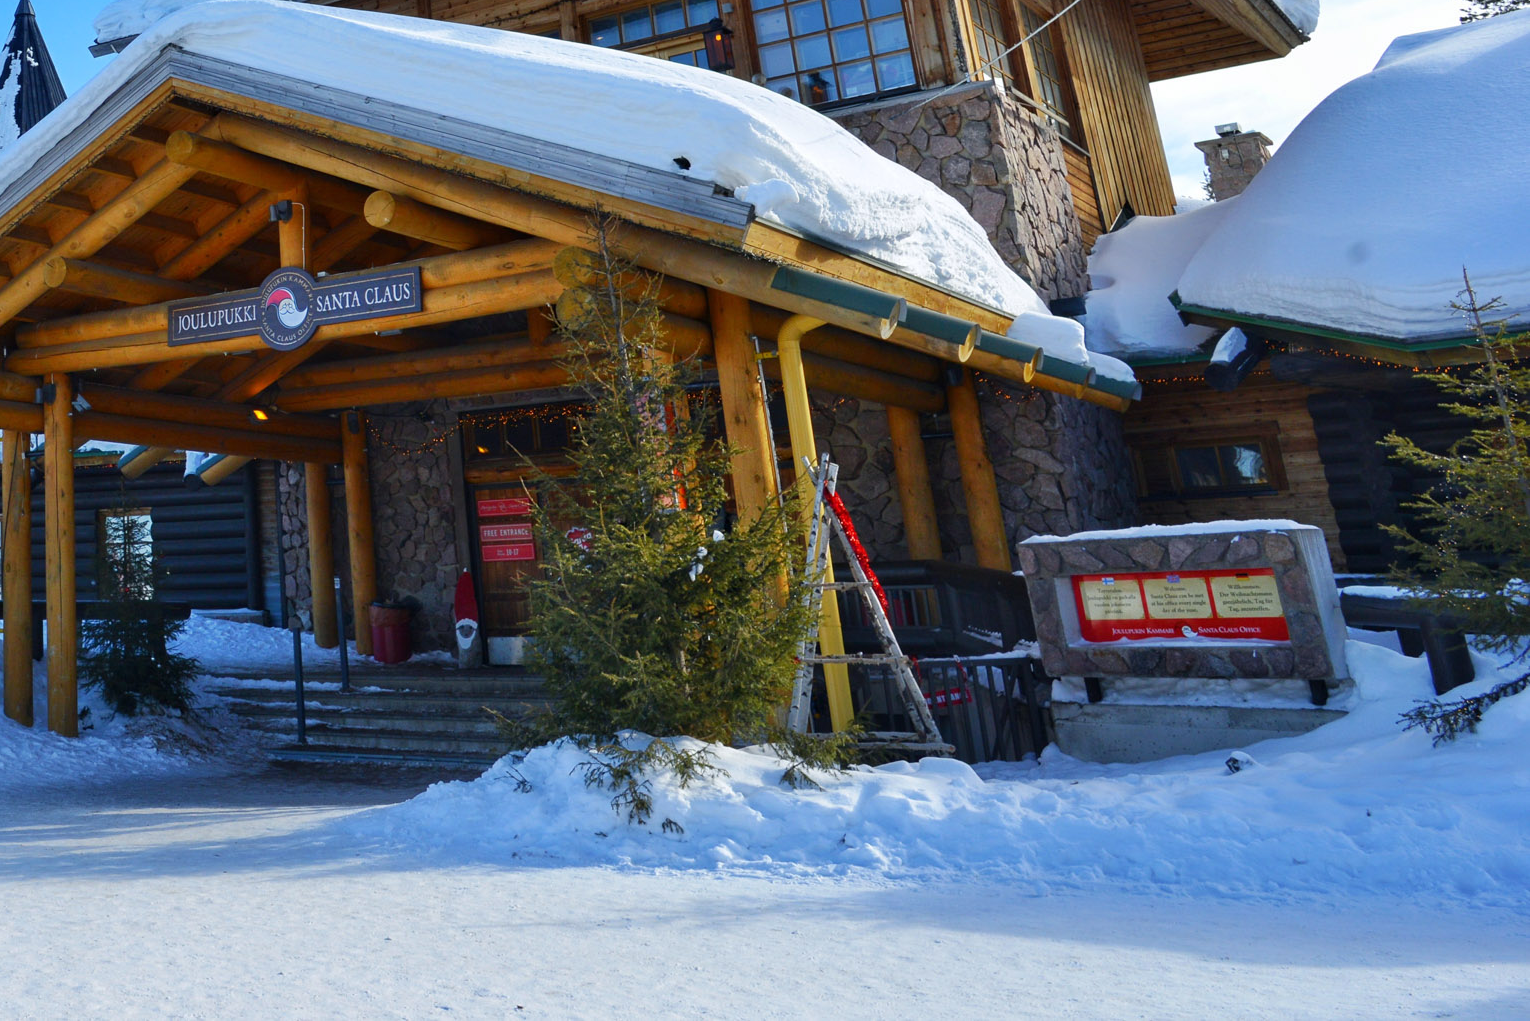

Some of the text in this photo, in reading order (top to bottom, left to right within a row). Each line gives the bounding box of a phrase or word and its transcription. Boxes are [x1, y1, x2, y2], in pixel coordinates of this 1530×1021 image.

[178, 282, 411, 334] JOULUPUKKI SANTA CLAUS
[277, 333, 297, 342] CLAUS
[484, 528, 529, 538] FREE ENTRANCE
[1197, 626, 1218, 634] SANTA
[1218, 626, 1239, 634] CLAUS
